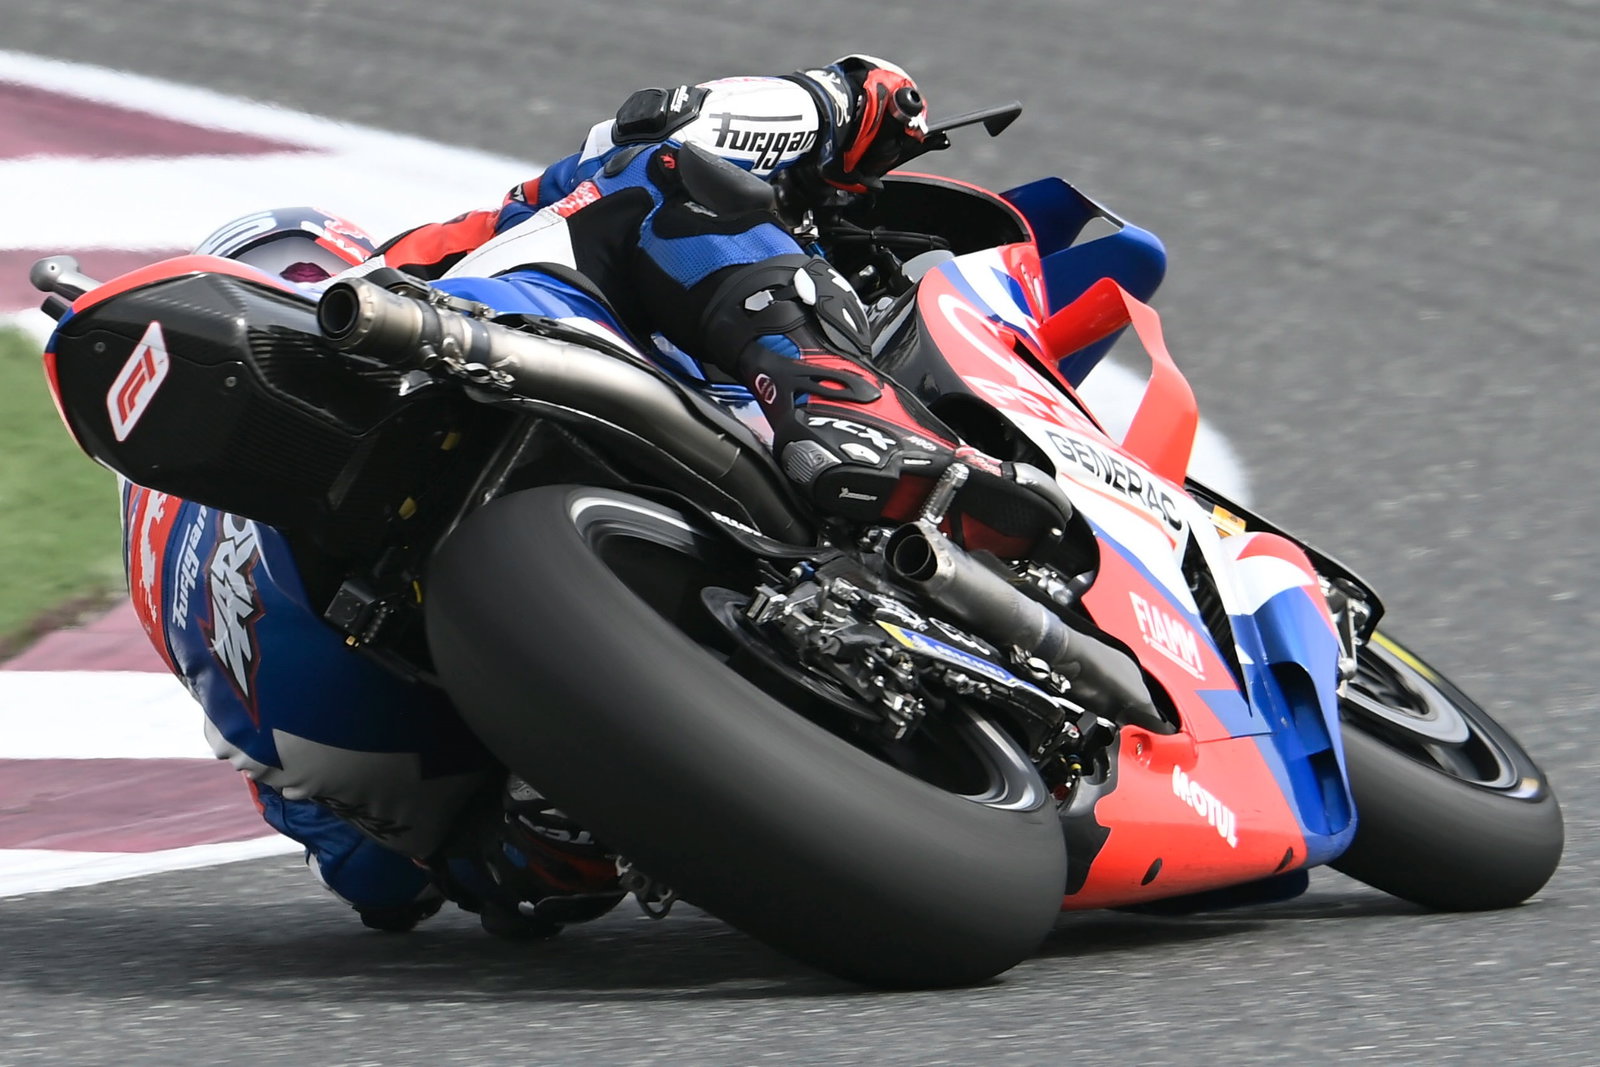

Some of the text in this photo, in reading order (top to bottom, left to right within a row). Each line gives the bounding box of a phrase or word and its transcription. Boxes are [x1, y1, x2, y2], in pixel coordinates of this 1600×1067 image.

[709, 112, 819, 170] Furygan
[808, 416, 897, 451] TCX
[1045, 430, 1182, 532] GENERAC
[1129, 591, 1205, 674] FIAMM
[1172, 764, 1239, 849] MOTUL
